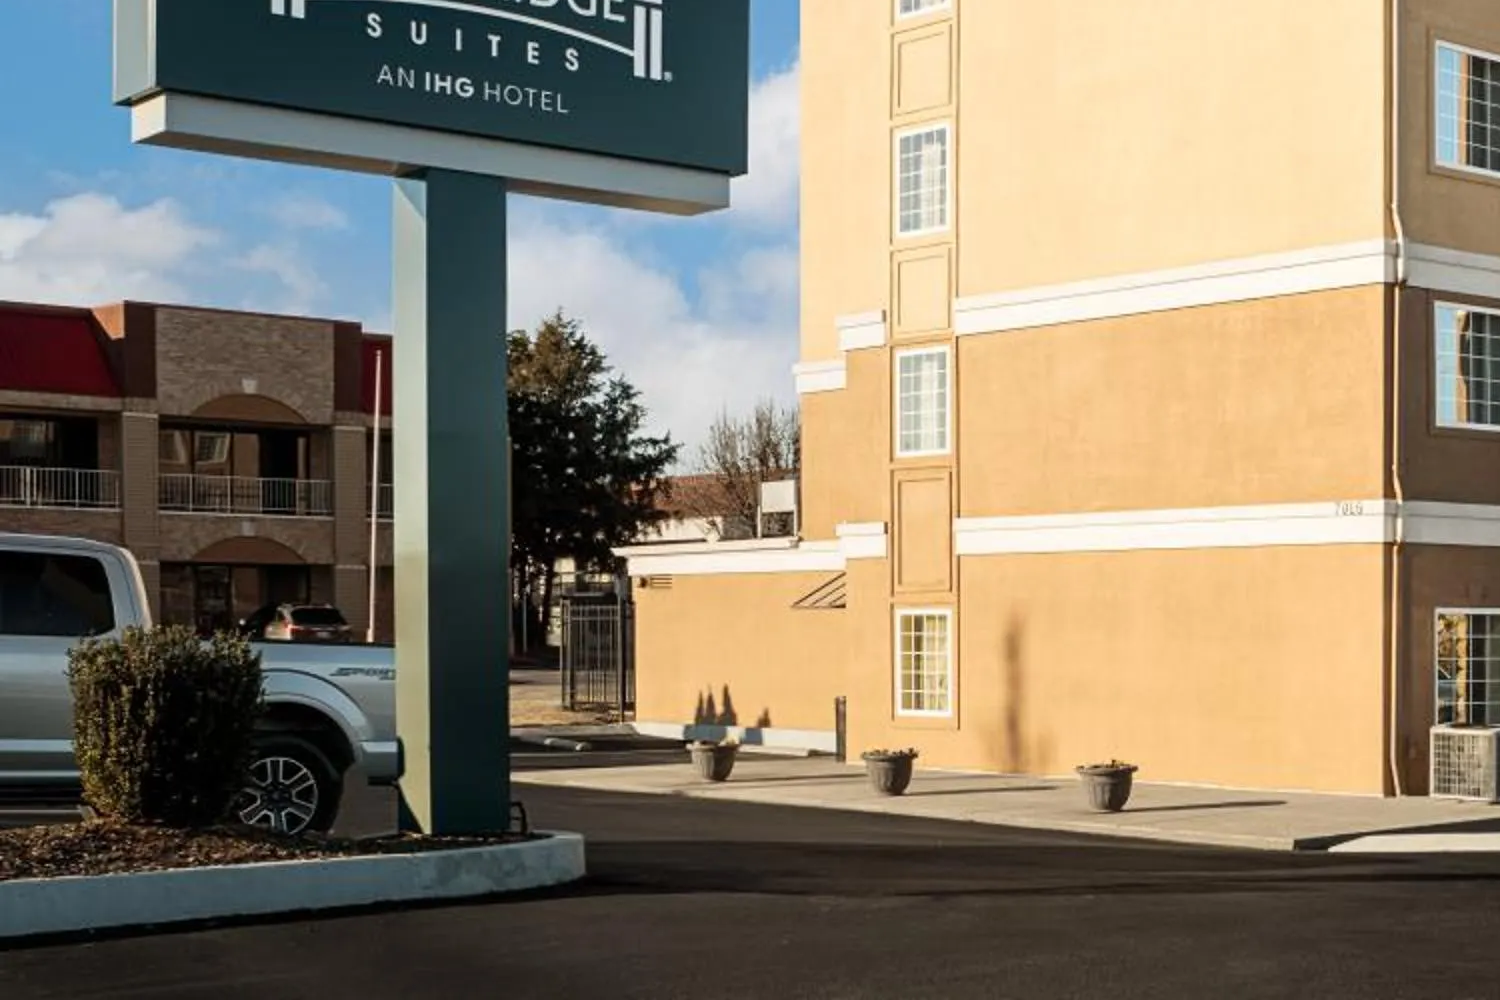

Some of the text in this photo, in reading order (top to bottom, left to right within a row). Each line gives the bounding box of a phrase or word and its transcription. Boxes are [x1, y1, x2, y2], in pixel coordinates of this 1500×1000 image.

[366, 12, 580, 72] SUITES
[377, 64, 569, 114] AN IHG HOTEL
